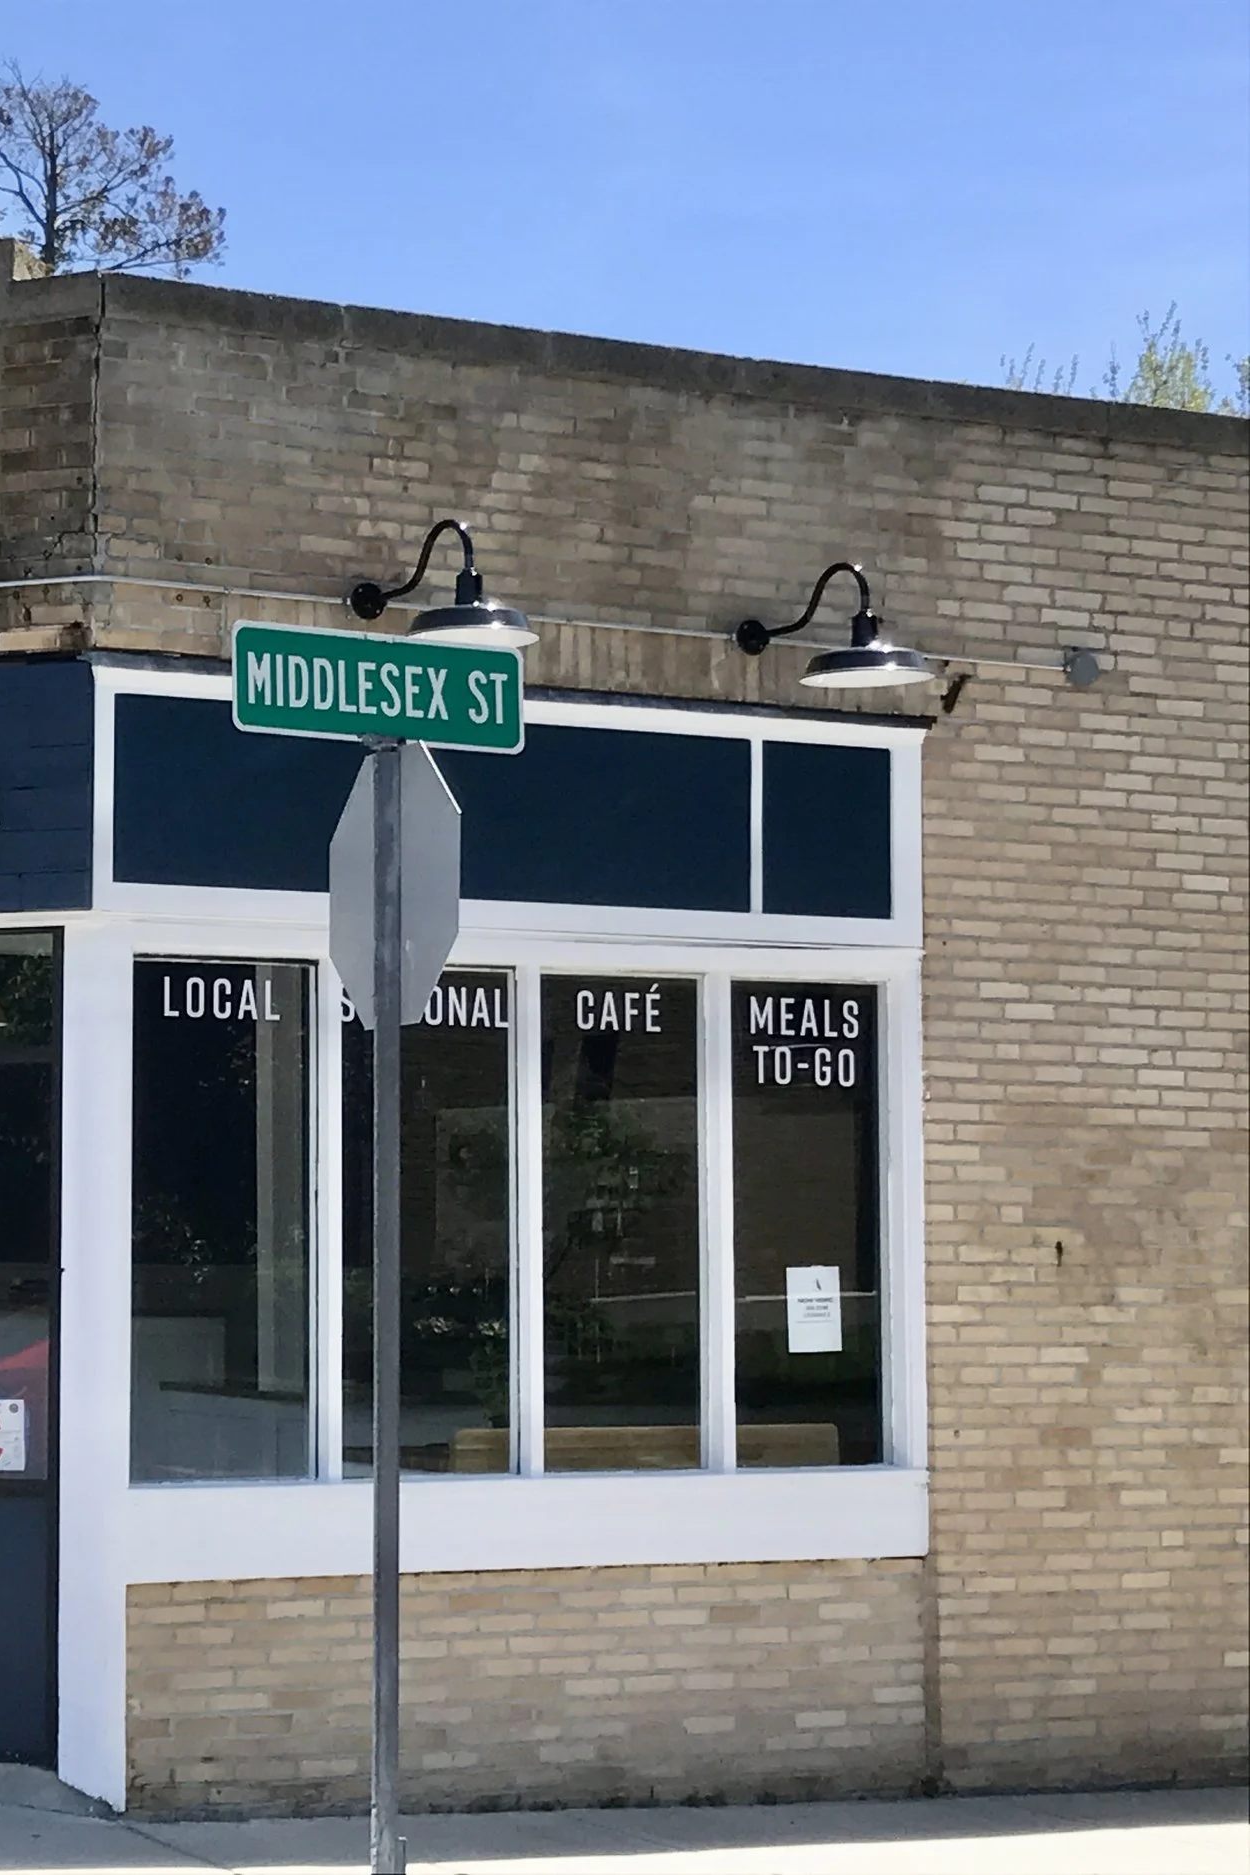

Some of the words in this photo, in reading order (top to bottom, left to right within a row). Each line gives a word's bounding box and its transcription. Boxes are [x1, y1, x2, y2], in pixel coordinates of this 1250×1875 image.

[247, 651, 449, 721] MIDDLESEX
[467, 669, 509, 725] ST
[163, 975, 281, 1021] LOCAL
[340, 985, 510, 1029] SONAL
[576, 982, 662, 1033] CAFÉ
[750, 995, 859, 1039] MEALS
[752, 1045, 855, 1088] TO-GO
